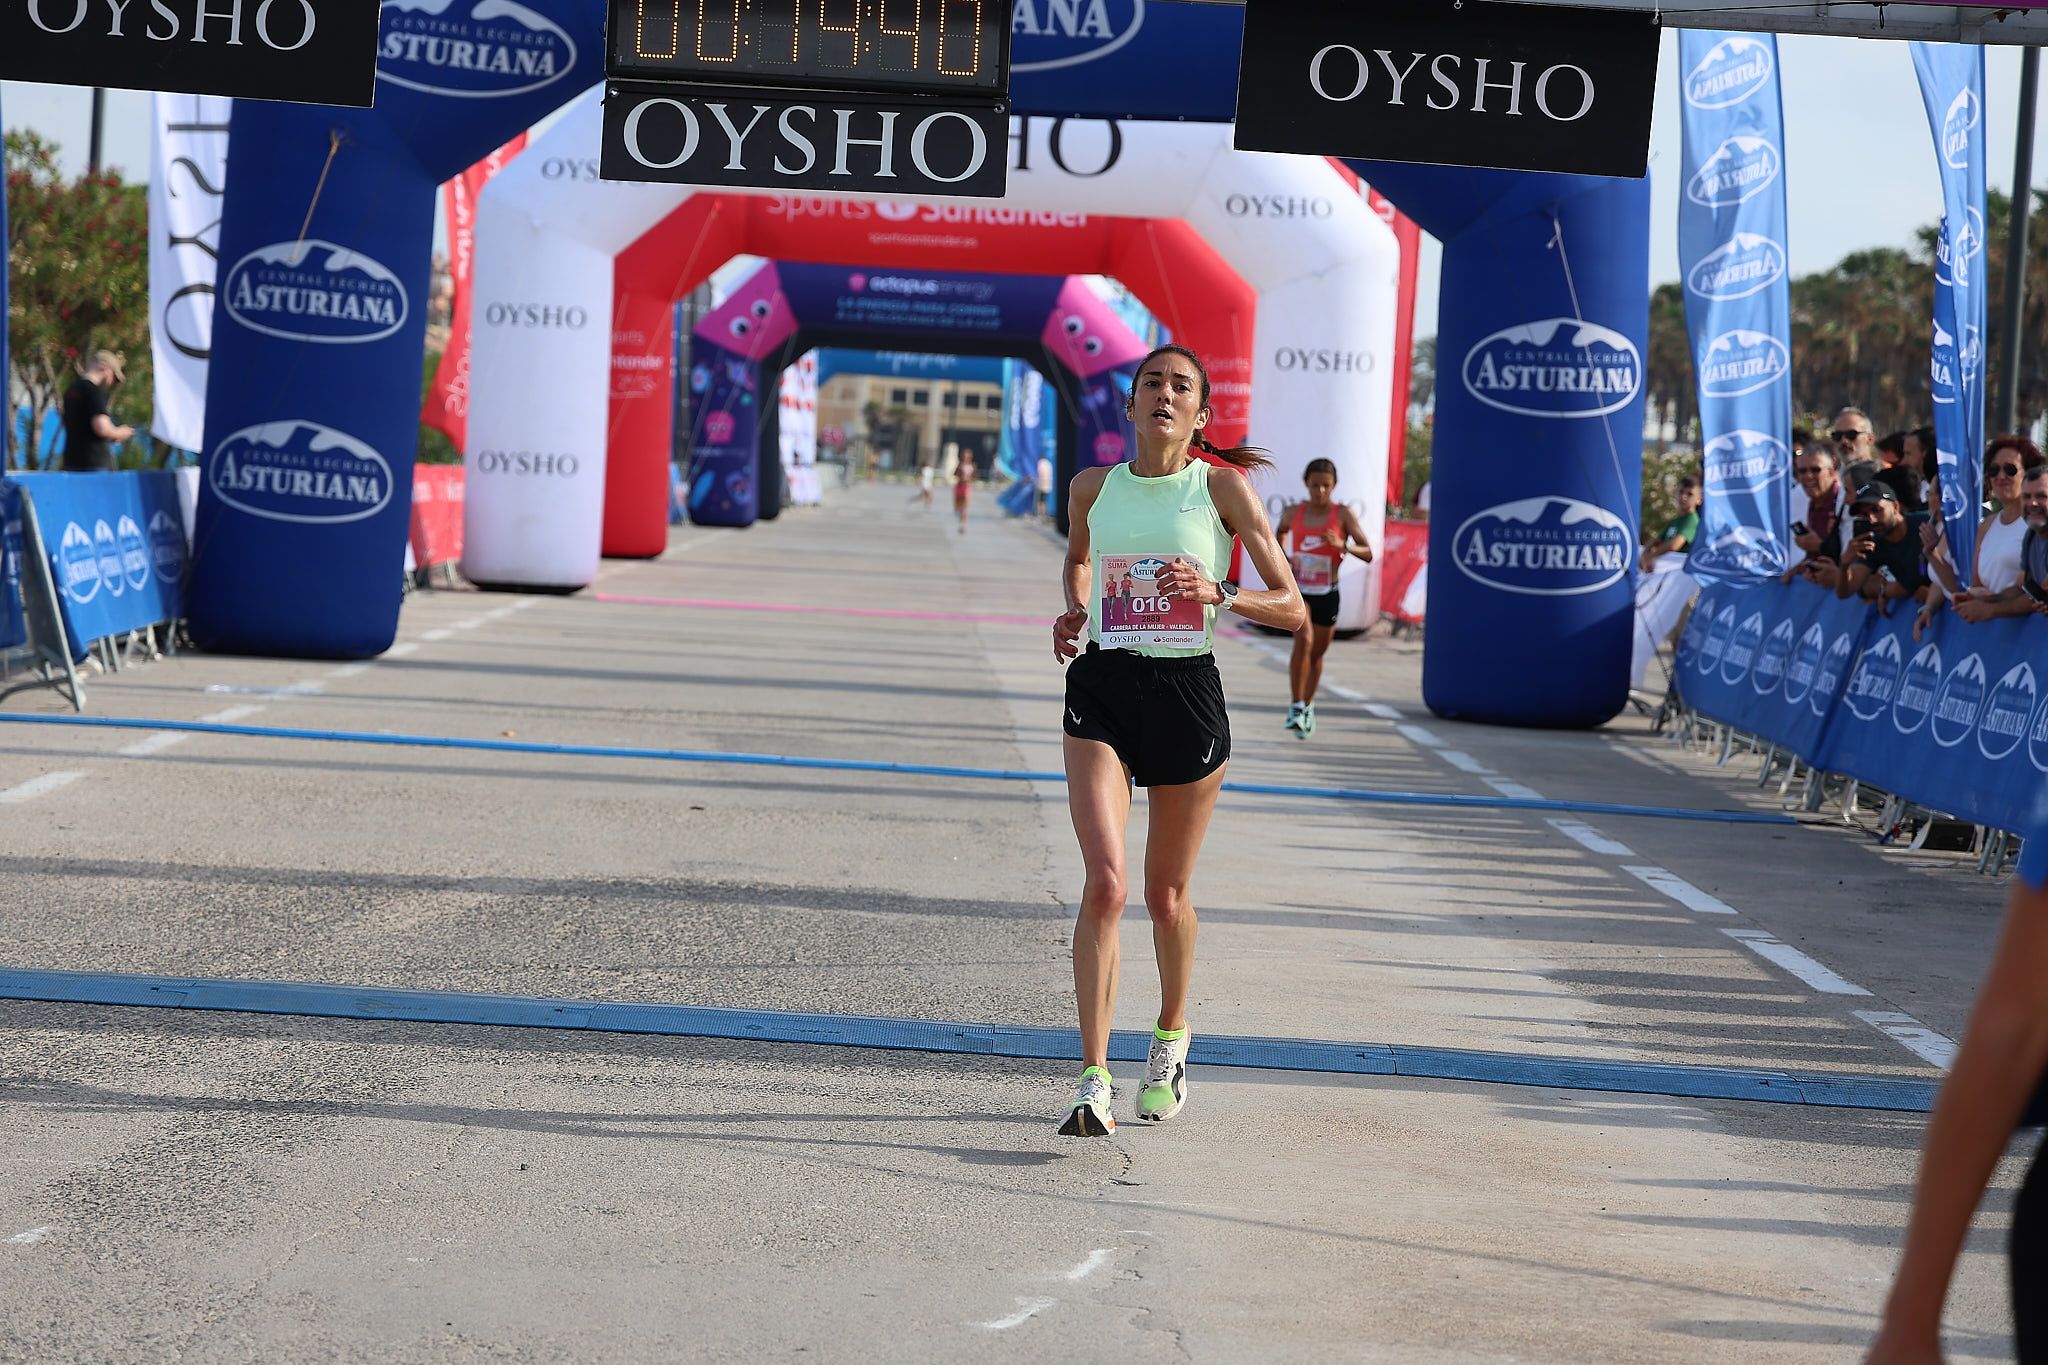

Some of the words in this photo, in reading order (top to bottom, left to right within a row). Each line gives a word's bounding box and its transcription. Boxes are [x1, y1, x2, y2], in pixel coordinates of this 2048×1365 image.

[27, 0, 316, 50] OYSHO
[378, 31, 555, 76] STURIANA
[1309, 44, 1595, 121] OYSHO
[623, 97, 987, 182] OYSHO
[1226, 193, 1333, 219] OYSHO
[233, 271, 396, 325] ASTURIANA
[485, 301, 588, 330] OYSHO
[1275, 346, 1375, 374] OYSHO
[1474, 351, 1634, 393] ASTURIANA
[217, 450, 381, 504] ASTURIANA
[477, 449, 579, 479] OYSHO
[1462, 527, 1624, 571] ASTURIANA
[1132, 596, 1171, 613] 016
[1109, 635, 1141, 643] OYSHO
[1169, 623, 1194, 631] VALENCIA
